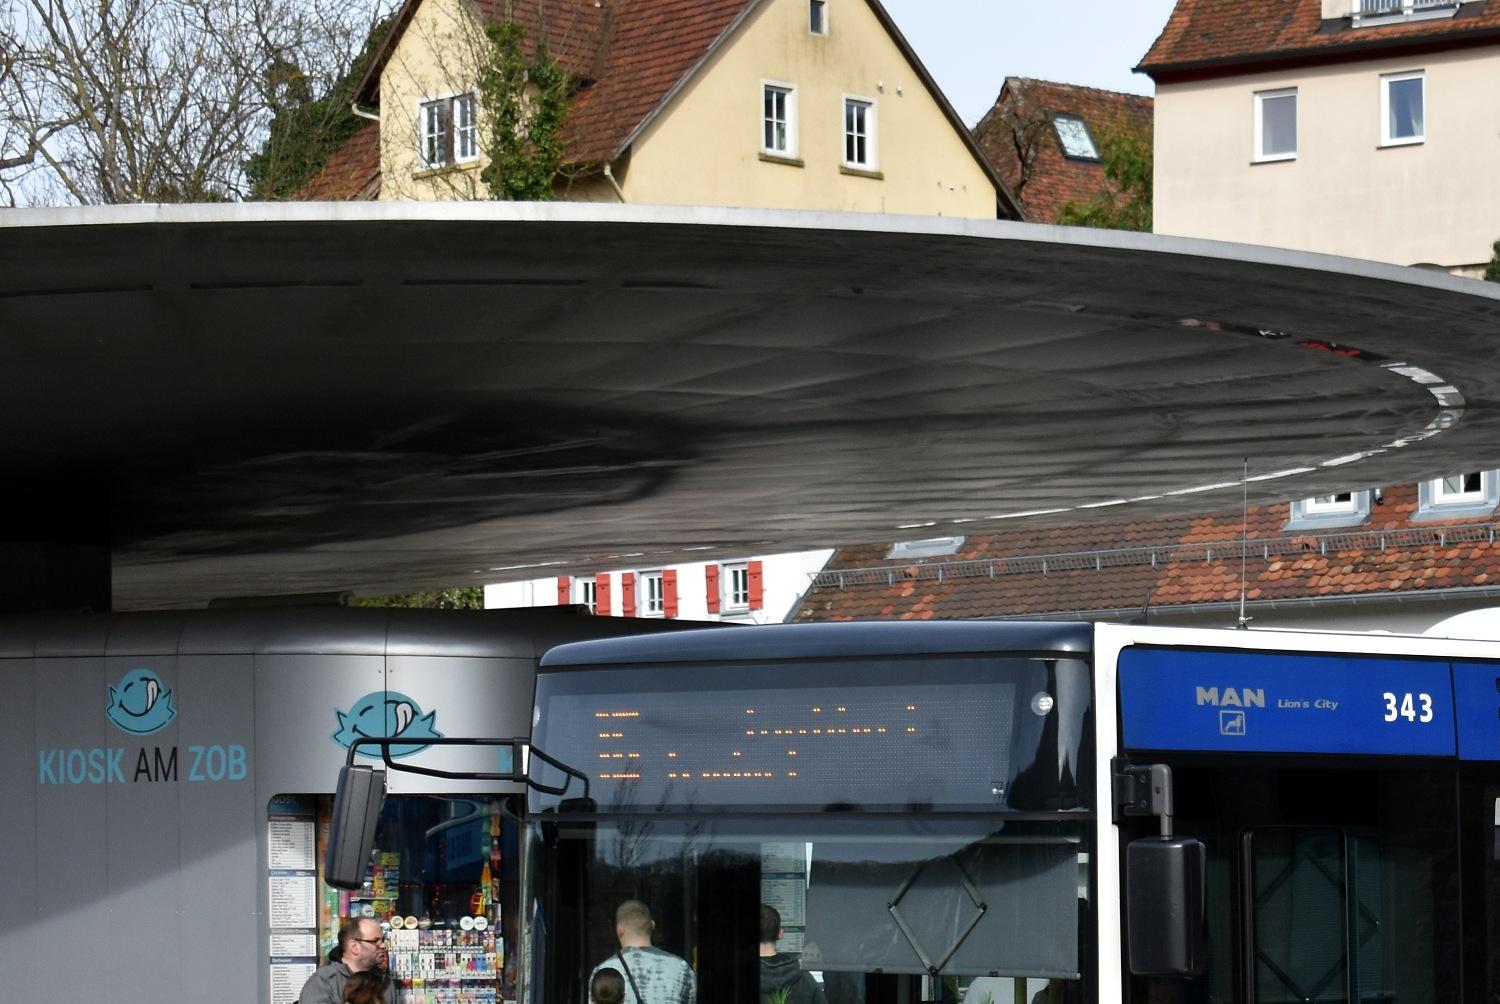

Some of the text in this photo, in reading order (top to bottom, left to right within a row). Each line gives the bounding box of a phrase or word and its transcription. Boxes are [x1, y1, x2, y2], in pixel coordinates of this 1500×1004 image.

[1196, 686, 1265, 708] MAN
[1314, 699, 1339, 711] City
[1383, 692, 1434, 723] 343
[38, 744, 248, 785] KIOSK AM ZOB
